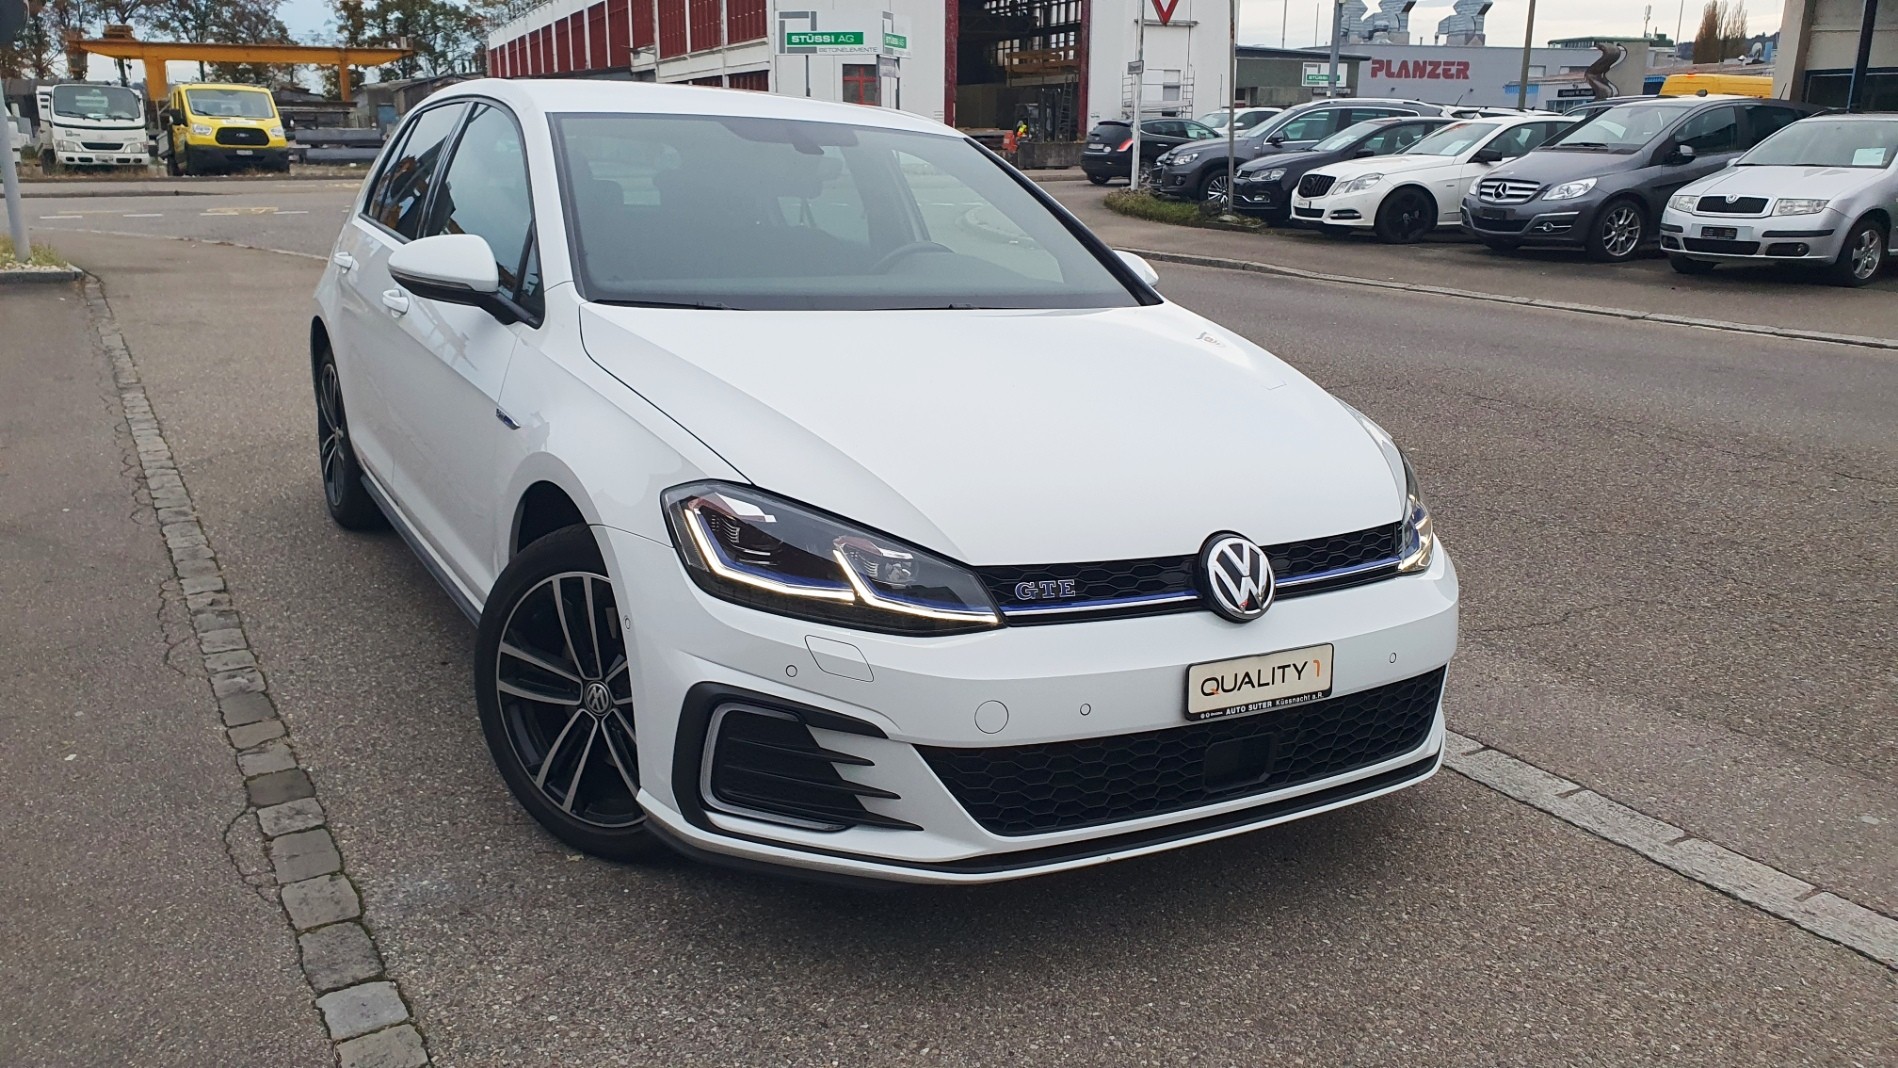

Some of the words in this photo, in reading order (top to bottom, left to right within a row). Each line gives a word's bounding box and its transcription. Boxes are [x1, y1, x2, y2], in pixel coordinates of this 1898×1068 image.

[791, 33, 835, 43] STÜSSI
[838, 34, 854, 43] AG
[1370, 58, 1470, 80] PLANZER
[1015, 579, 1076, 600] GTE
[1200, 660, 1308, 696] QUALITY
[1226, 705, 1246, 716] AUTO
[1248, 700, 1272, 711] SUTER
